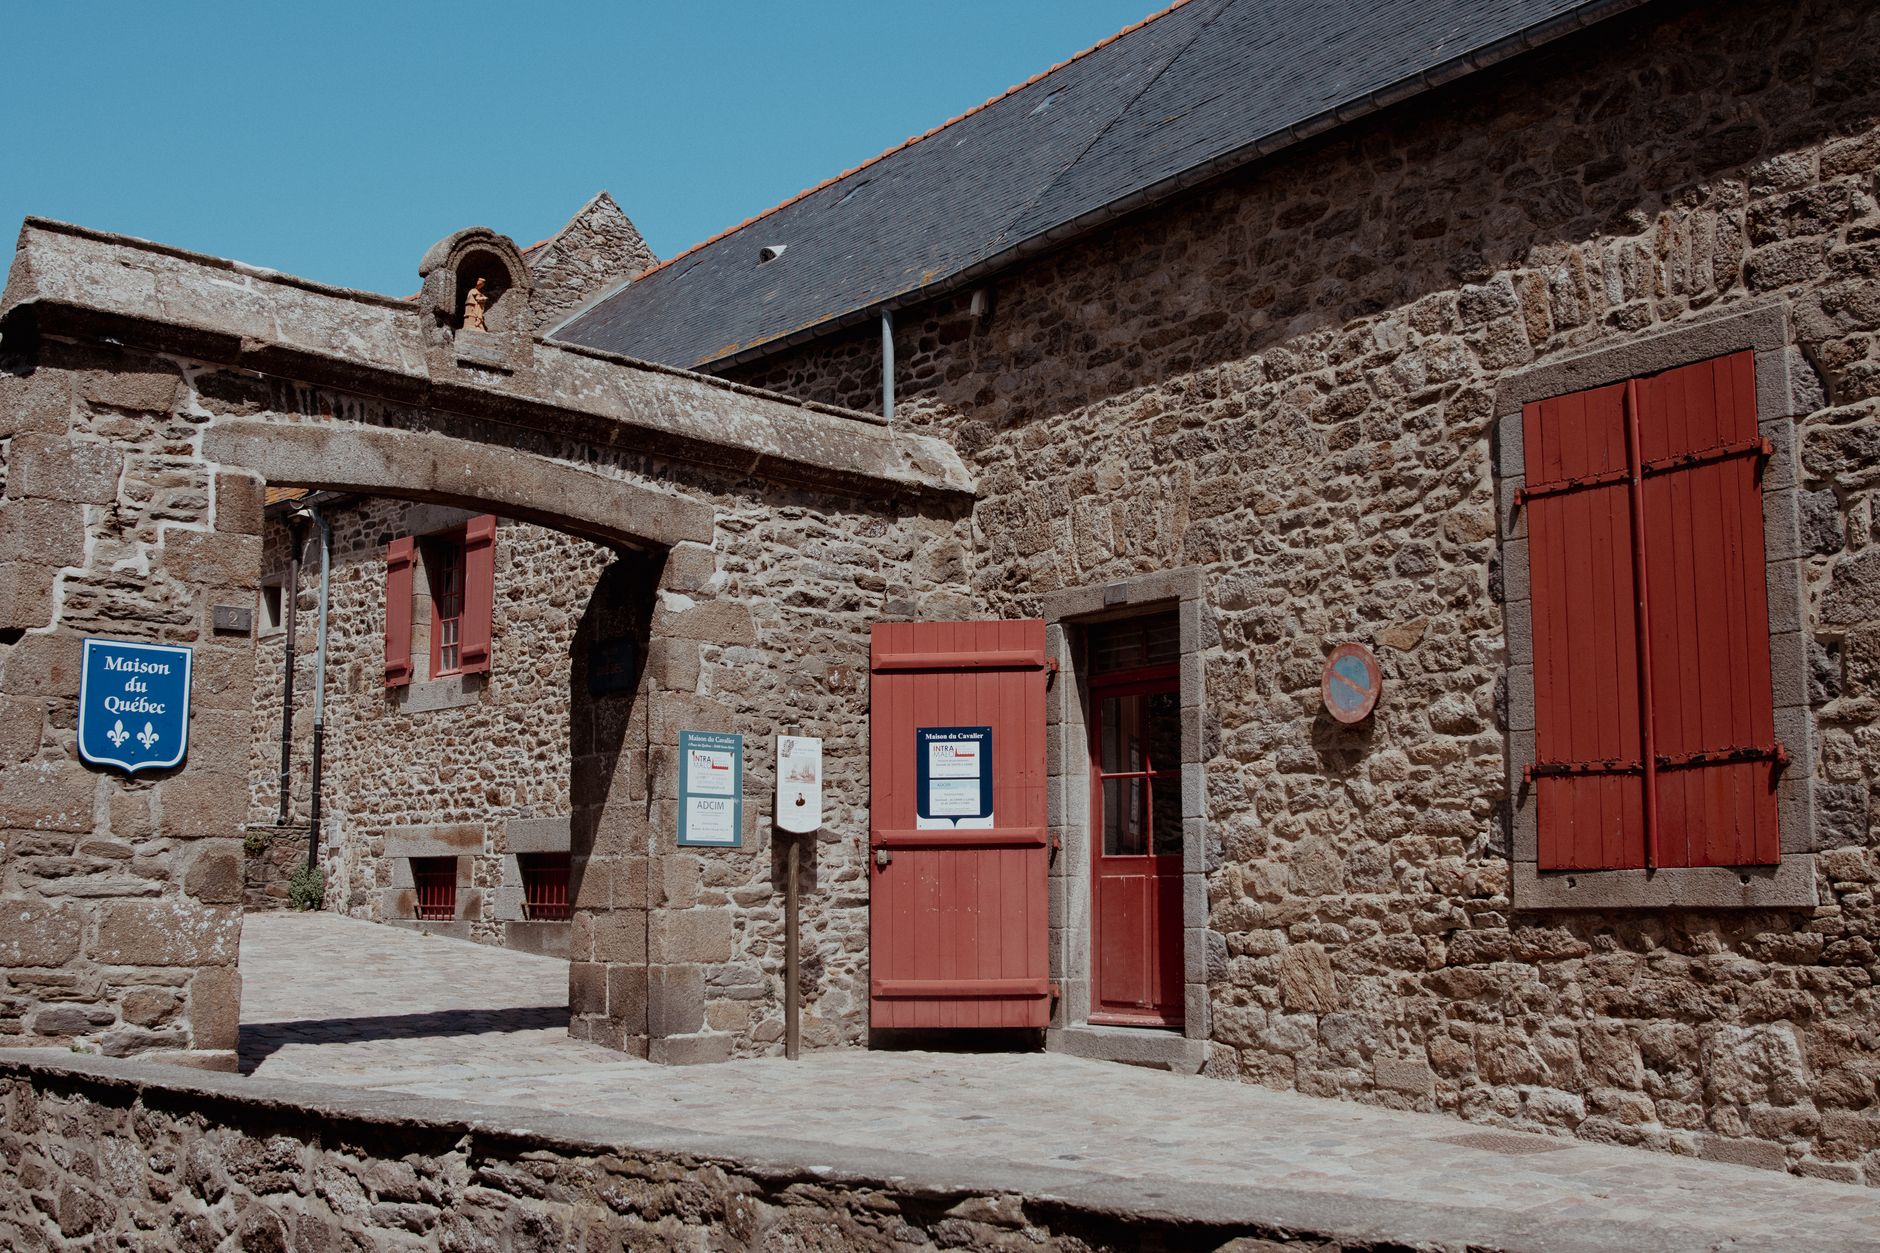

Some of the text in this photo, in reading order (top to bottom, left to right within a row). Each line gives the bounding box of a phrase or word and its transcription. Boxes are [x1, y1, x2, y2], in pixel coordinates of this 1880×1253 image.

[228, 611, 239, 627] 2
[104, 655, 171, 675] Maison
[124, 676, 148, 693] du
[104, 695, 166, 715] Québec
[957, 732, 984, 740] Cavalier
[697, 801, 725, 810] ADCIM
